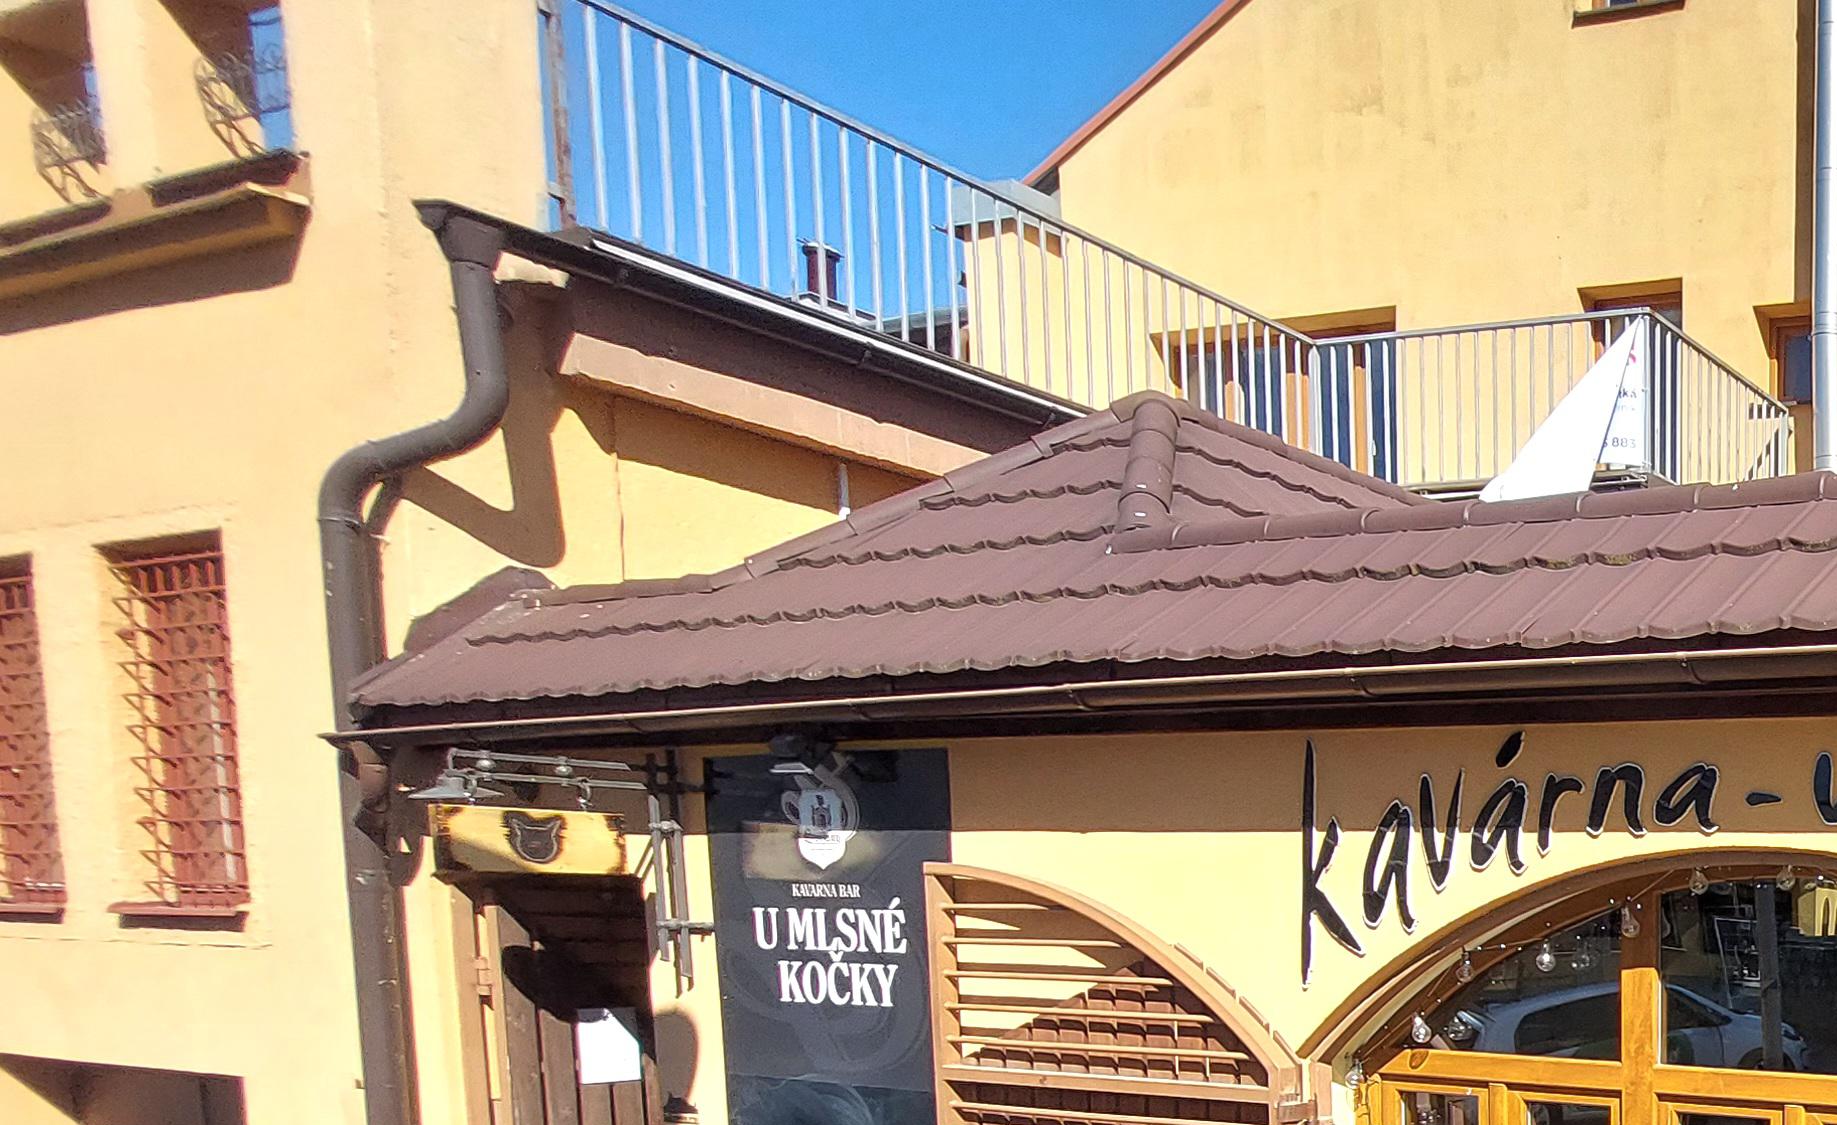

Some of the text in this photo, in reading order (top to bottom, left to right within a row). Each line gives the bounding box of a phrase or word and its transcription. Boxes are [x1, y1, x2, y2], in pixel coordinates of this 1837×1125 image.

[1299, 730, 1721, 989] kavárna
[838, 884, 861, 898] BAR
[751, 897, 907, 954] U MLSNÉ
[776, 949, 899, 1007] KOČKY
